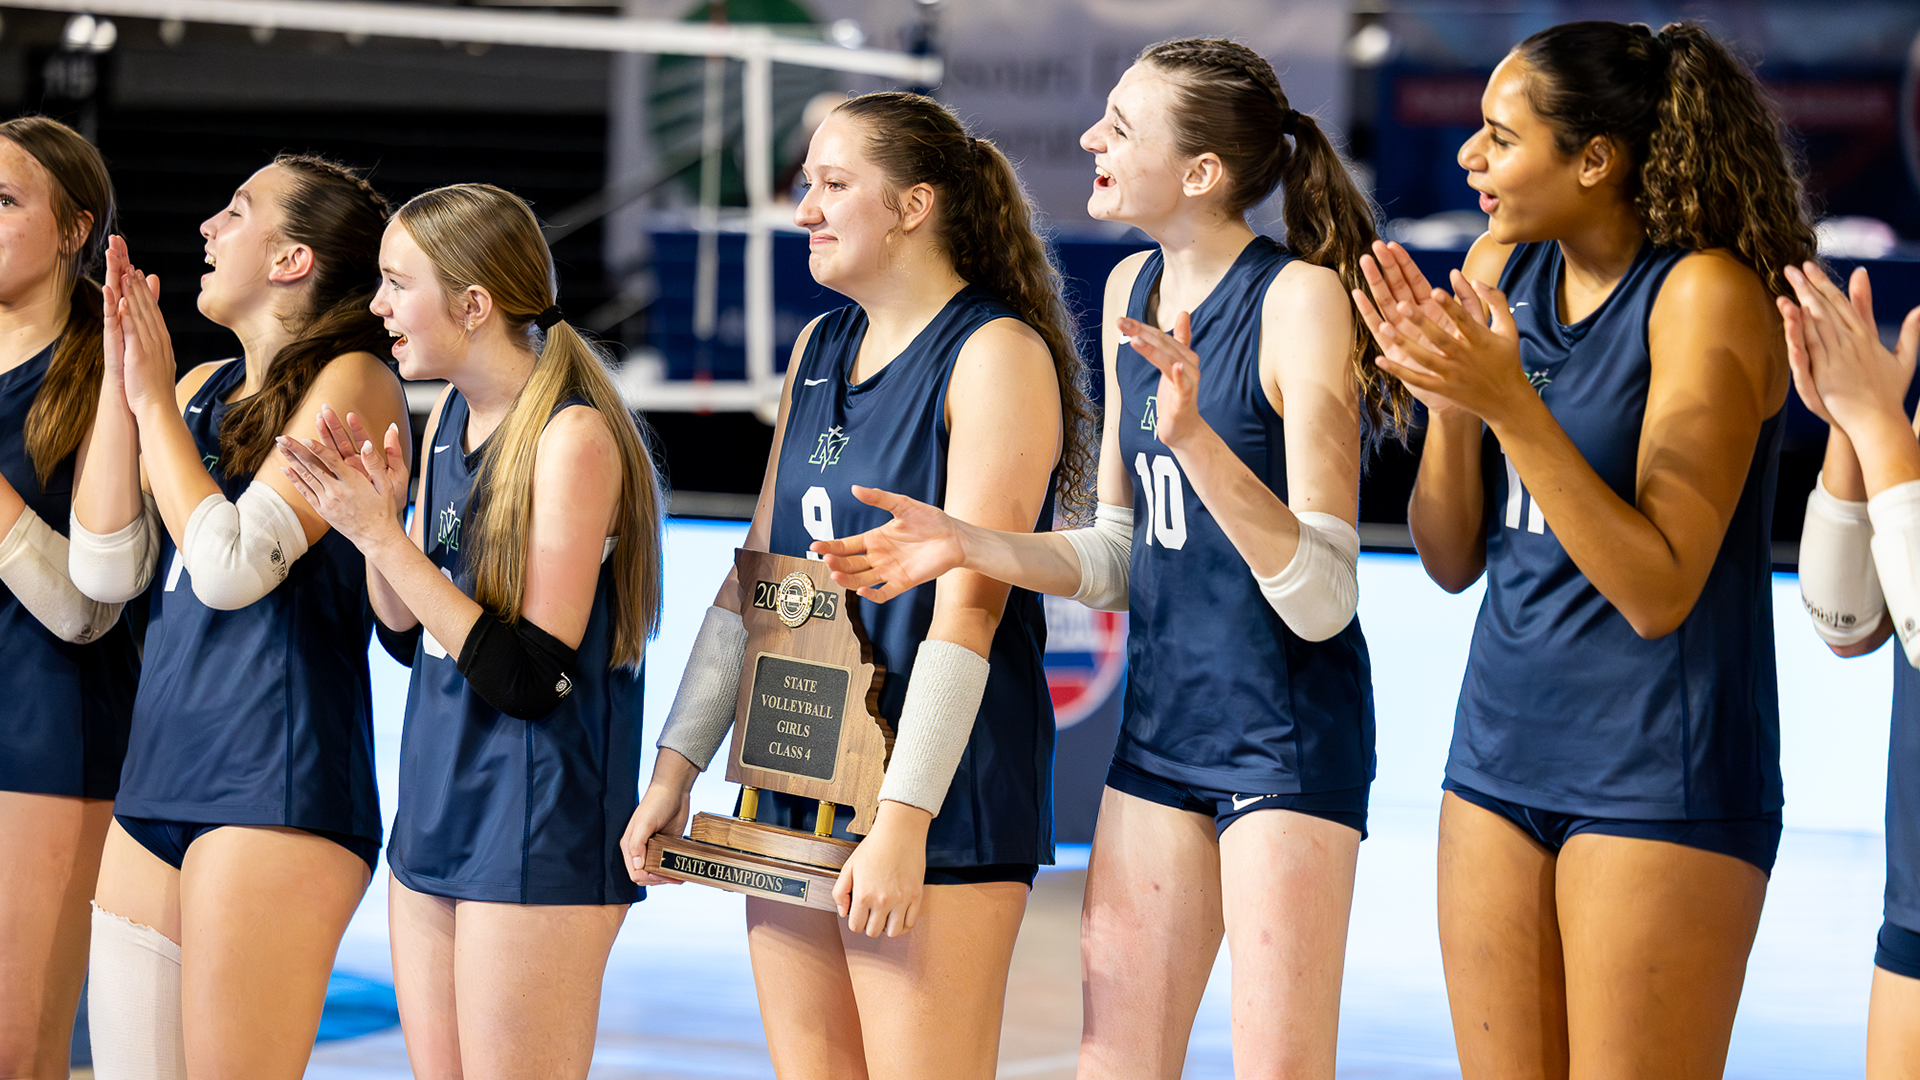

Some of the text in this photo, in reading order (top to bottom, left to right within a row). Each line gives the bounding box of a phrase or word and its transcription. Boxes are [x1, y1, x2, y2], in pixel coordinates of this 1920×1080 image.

[1134, 451, 1188, 551] 10
[754, 582, 778, 609] 20
[813, 591, 838, 619] 25
[783, 675, 818, 694] STATE
[761, 693, 834, 720] VOLLEYBALL
[777, 719, 811, 738] GIRLS
[768, 741, 812, 761] CLASS 4
[674, 855, 784, 892] STATE CHAMPIONS
